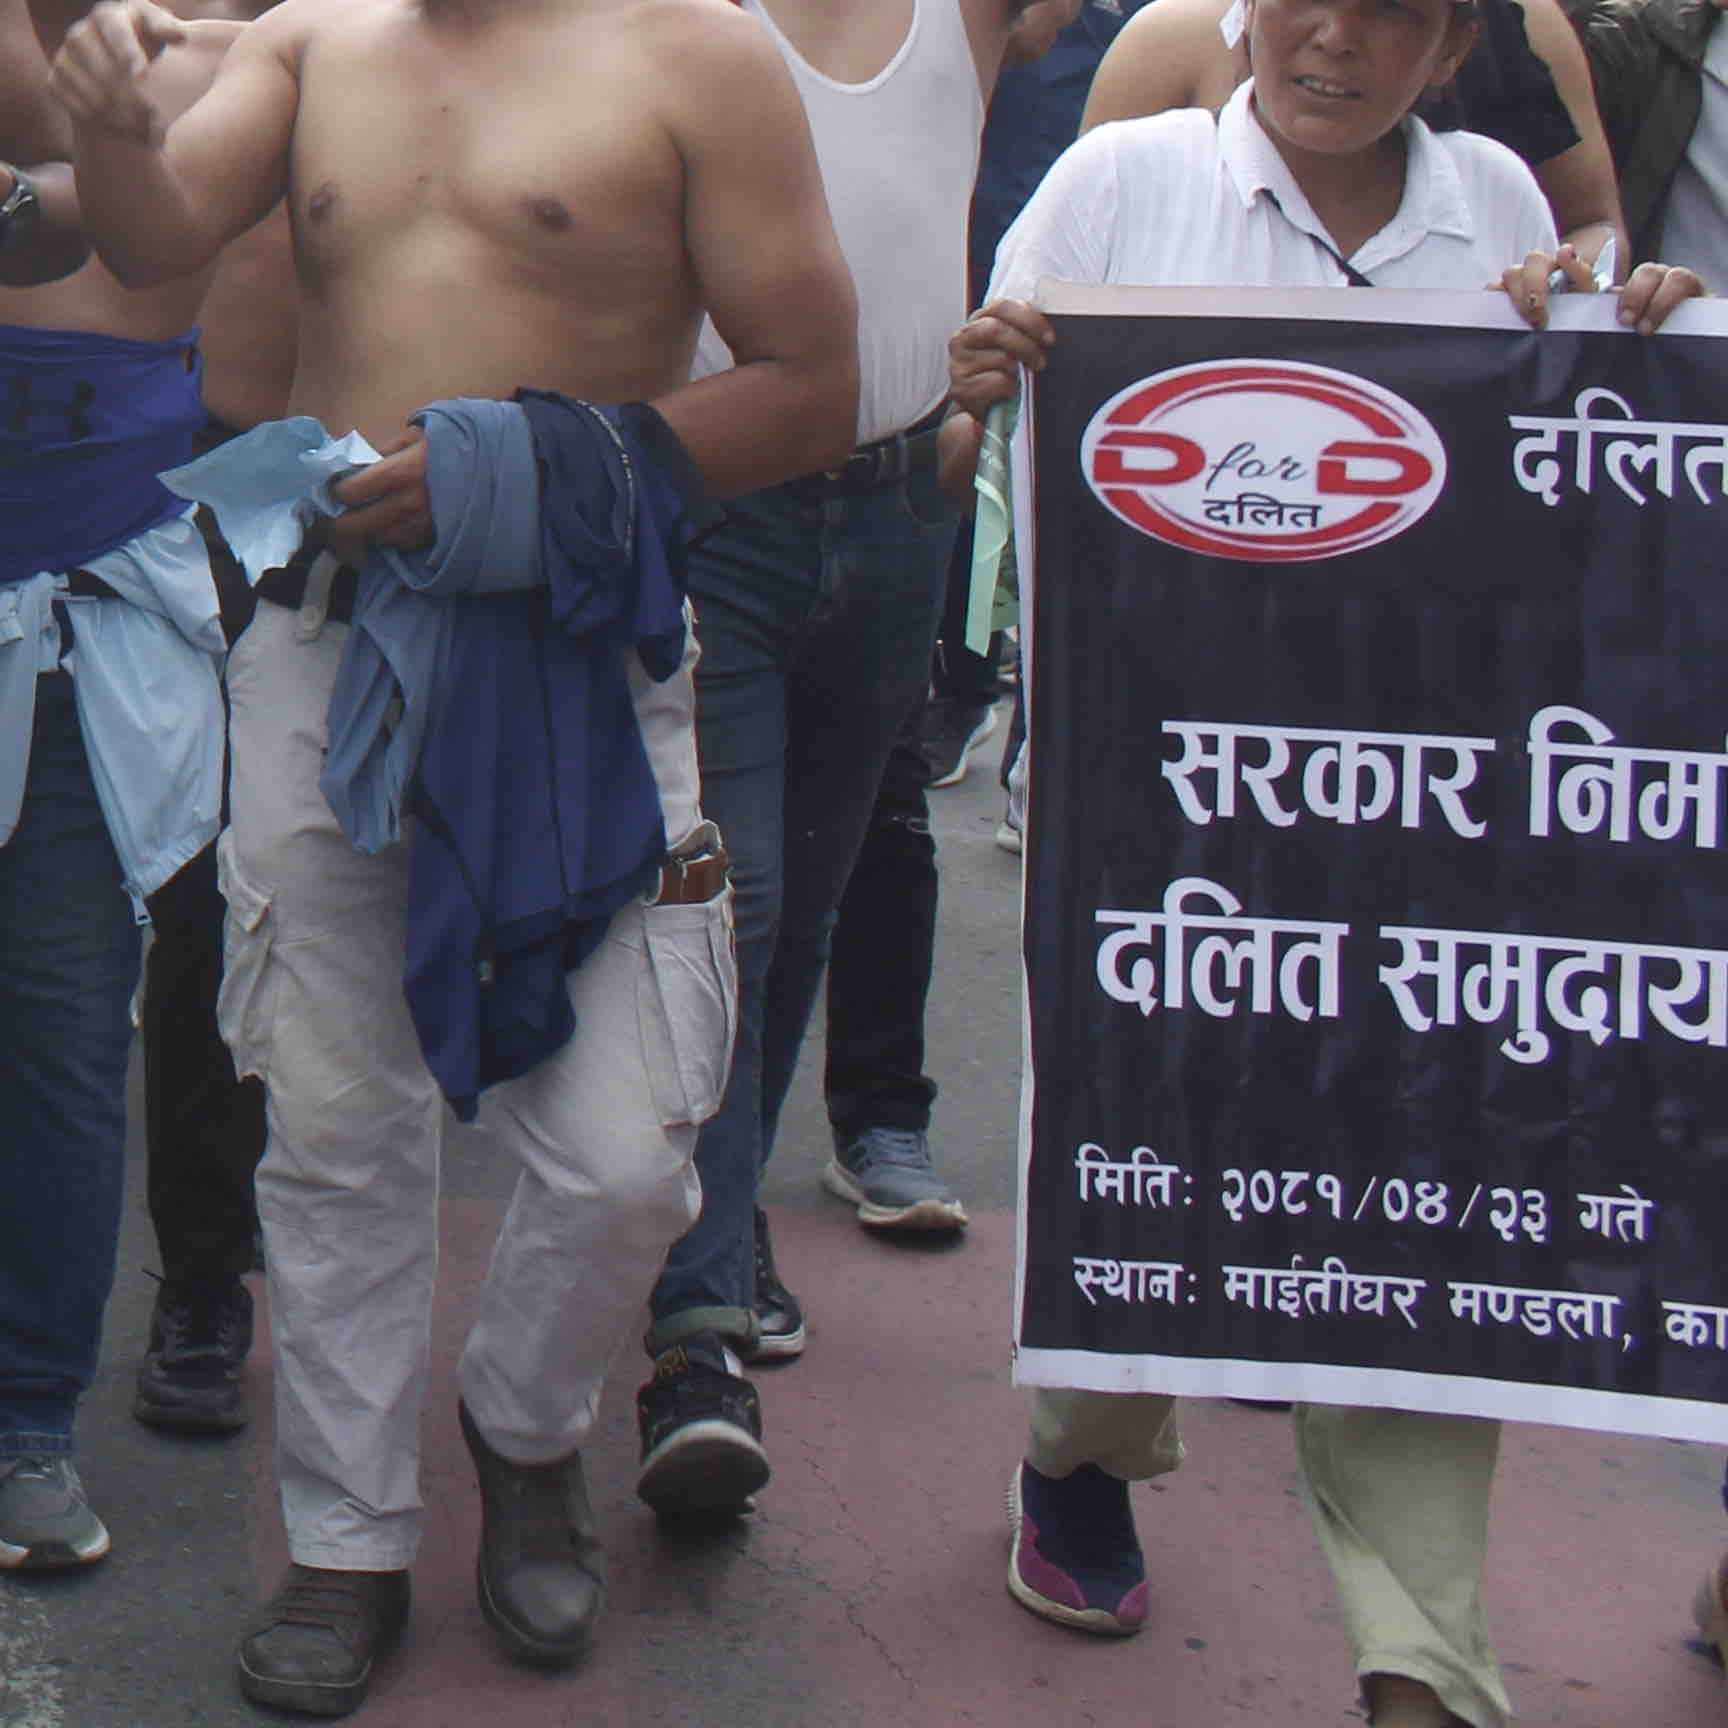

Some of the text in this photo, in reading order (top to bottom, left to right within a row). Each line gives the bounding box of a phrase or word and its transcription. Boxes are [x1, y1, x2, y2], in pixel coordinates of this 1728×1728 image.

[1093, 431, 1433, 495] D for D
[1201, 493, 1320, 529] दलित
[1161, 705, 1728, 849] सरकार निम
[1095, 877, 1728, 1064] दलित समुदाय
[1221, 1168, 1547, 1243] २०८१/०४/२३
[1576, 1183, 1654, 1242] गते
[1222, 1254, 1426, 1329] माईतीघर
